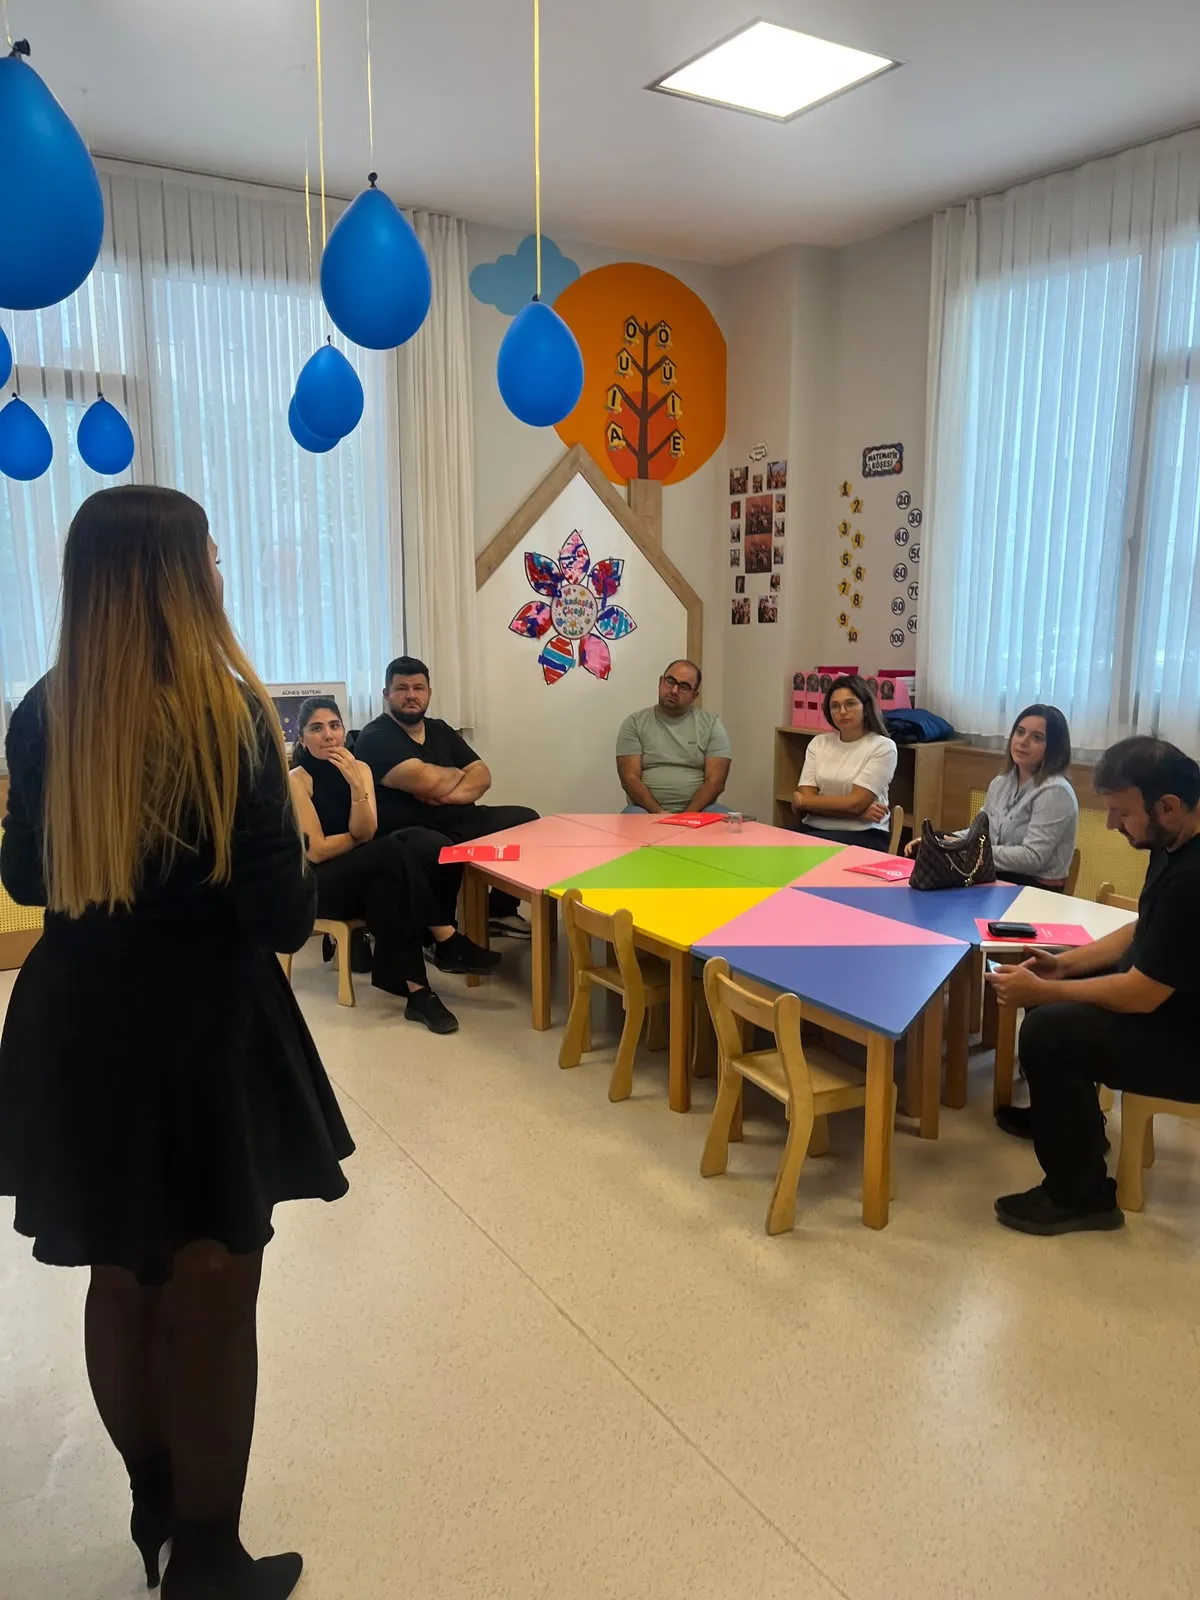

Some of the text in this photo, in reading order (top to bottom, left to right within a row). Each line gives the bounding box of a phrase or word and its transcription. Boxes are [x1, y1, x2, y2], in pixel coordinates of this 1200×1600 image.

[626, 322, 637, 338] O
[659, 323, 669, 343] Ö
[619, 357, 629, 371] U
[663, 362, 672, 380] Ü
[611, 390, 617, 407] I
[671, 395, 675, 413] İ
[610, 428, 621, 442] A
[672, 437, 681, 451] E
[868, 450, 898, 461] MATEMATİK
[872, 460, 893, 469] KÖŞESİ
[842, 481, 848, 496] 1
[854, 500, 859, 512] 2
[898, 495, 909, 505] 20
[910, 512, 921, 523] 30
[841, 522, 847, 535] 3
[855, 533, 860, 546] 4
[896, 531, 907, 542] 40
[842, 553, 848, 566] 5
[856, 566, 862, 579] 6
[895, 567, 905, 578] 60
[841, 582, 846, 593] 7
[853, 594, 859, 606] 8
[893, 601, 903, 611] 80
[840, 613, 846, 625] 9
[848, 631, 857, 641] 10
[892, 633, 902, 643] 100
